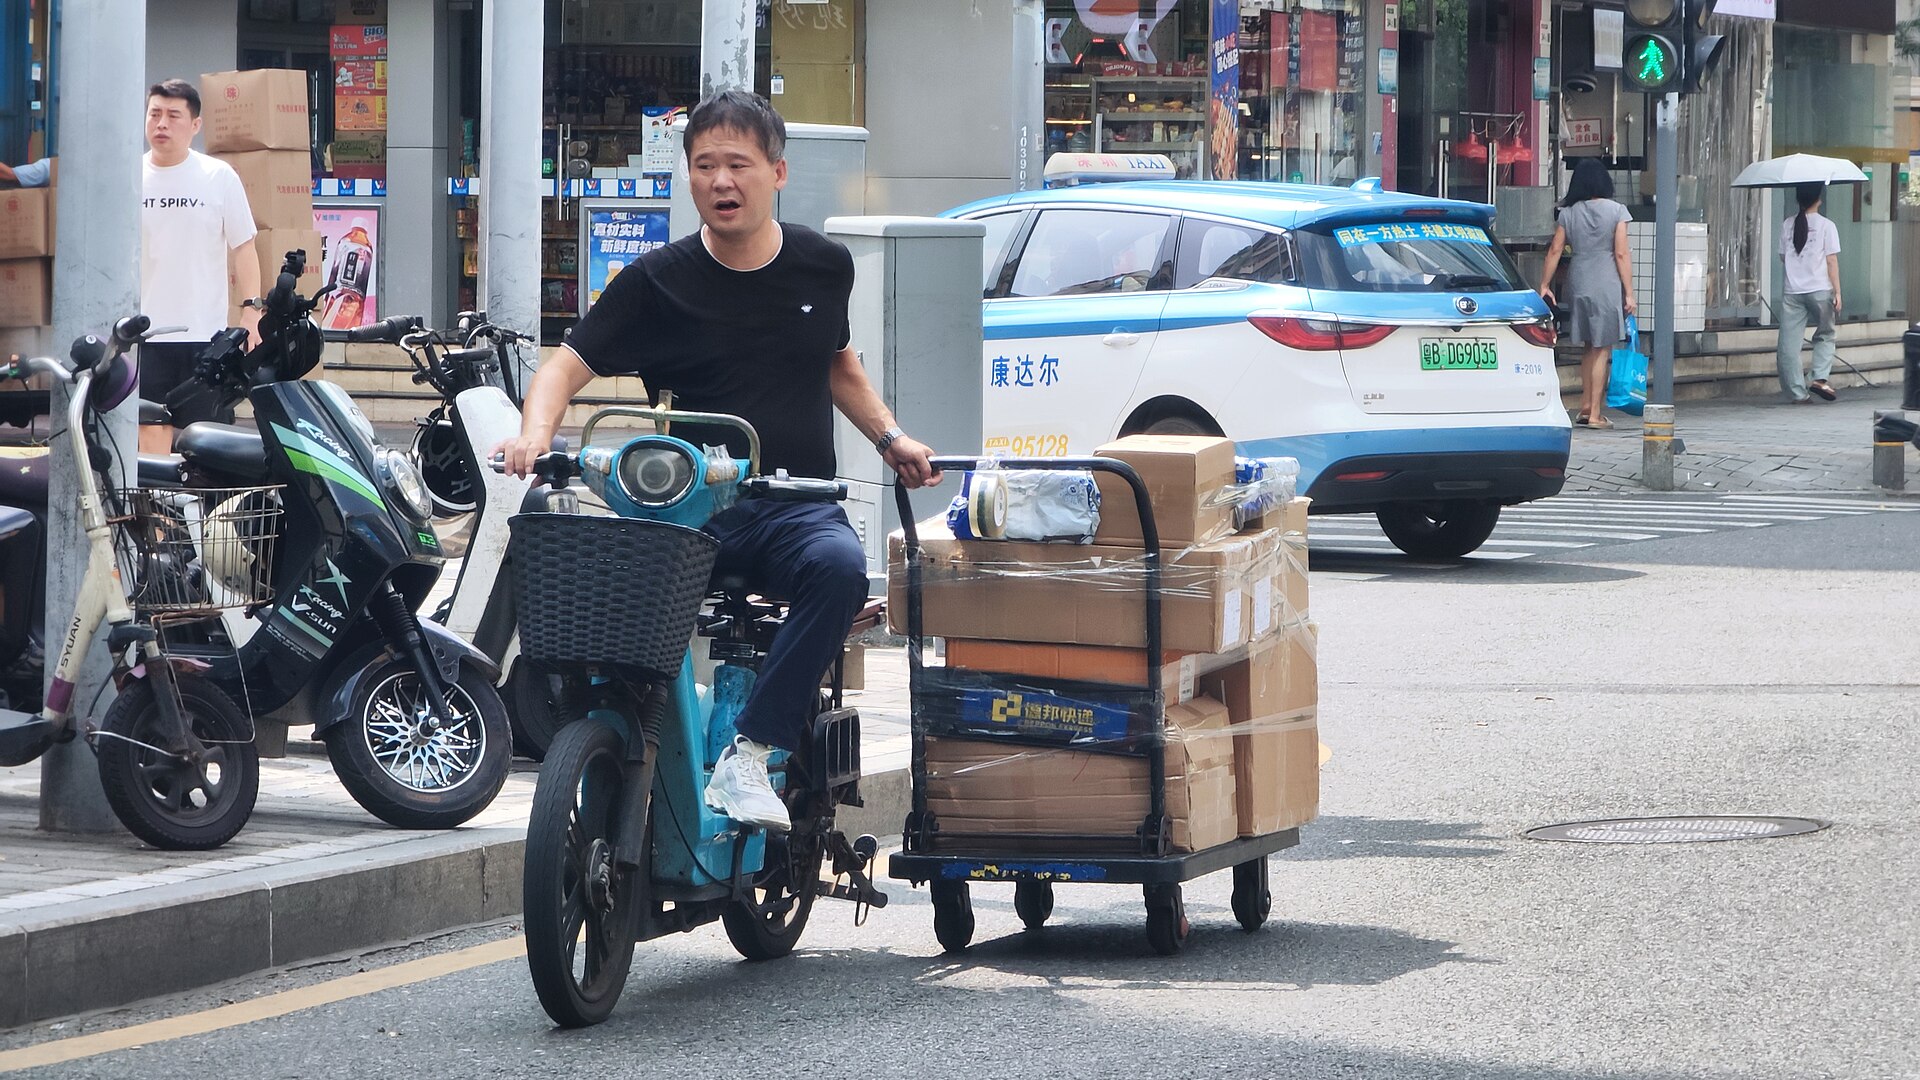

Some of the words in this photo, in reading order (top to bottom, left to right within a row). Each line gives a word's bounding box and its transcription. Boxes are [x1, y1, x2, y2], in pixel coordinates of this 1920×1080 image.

[1019, 125, 1027, 192] 103902
[1126, 156, 1167, 169] TAXI
[1337, 225, 1419, 245] 同在一方热土
[1447, 342, 1497, 365] DG9035
[991, 354, 1059, 387] 康达尔
[988, 438, 1008, 448] TAXI
[1011, 434, 1069, 457] 95128
[60, 616, 82, 668] SYUAN
[1024, 702, 1094, 726] 德邦快递
